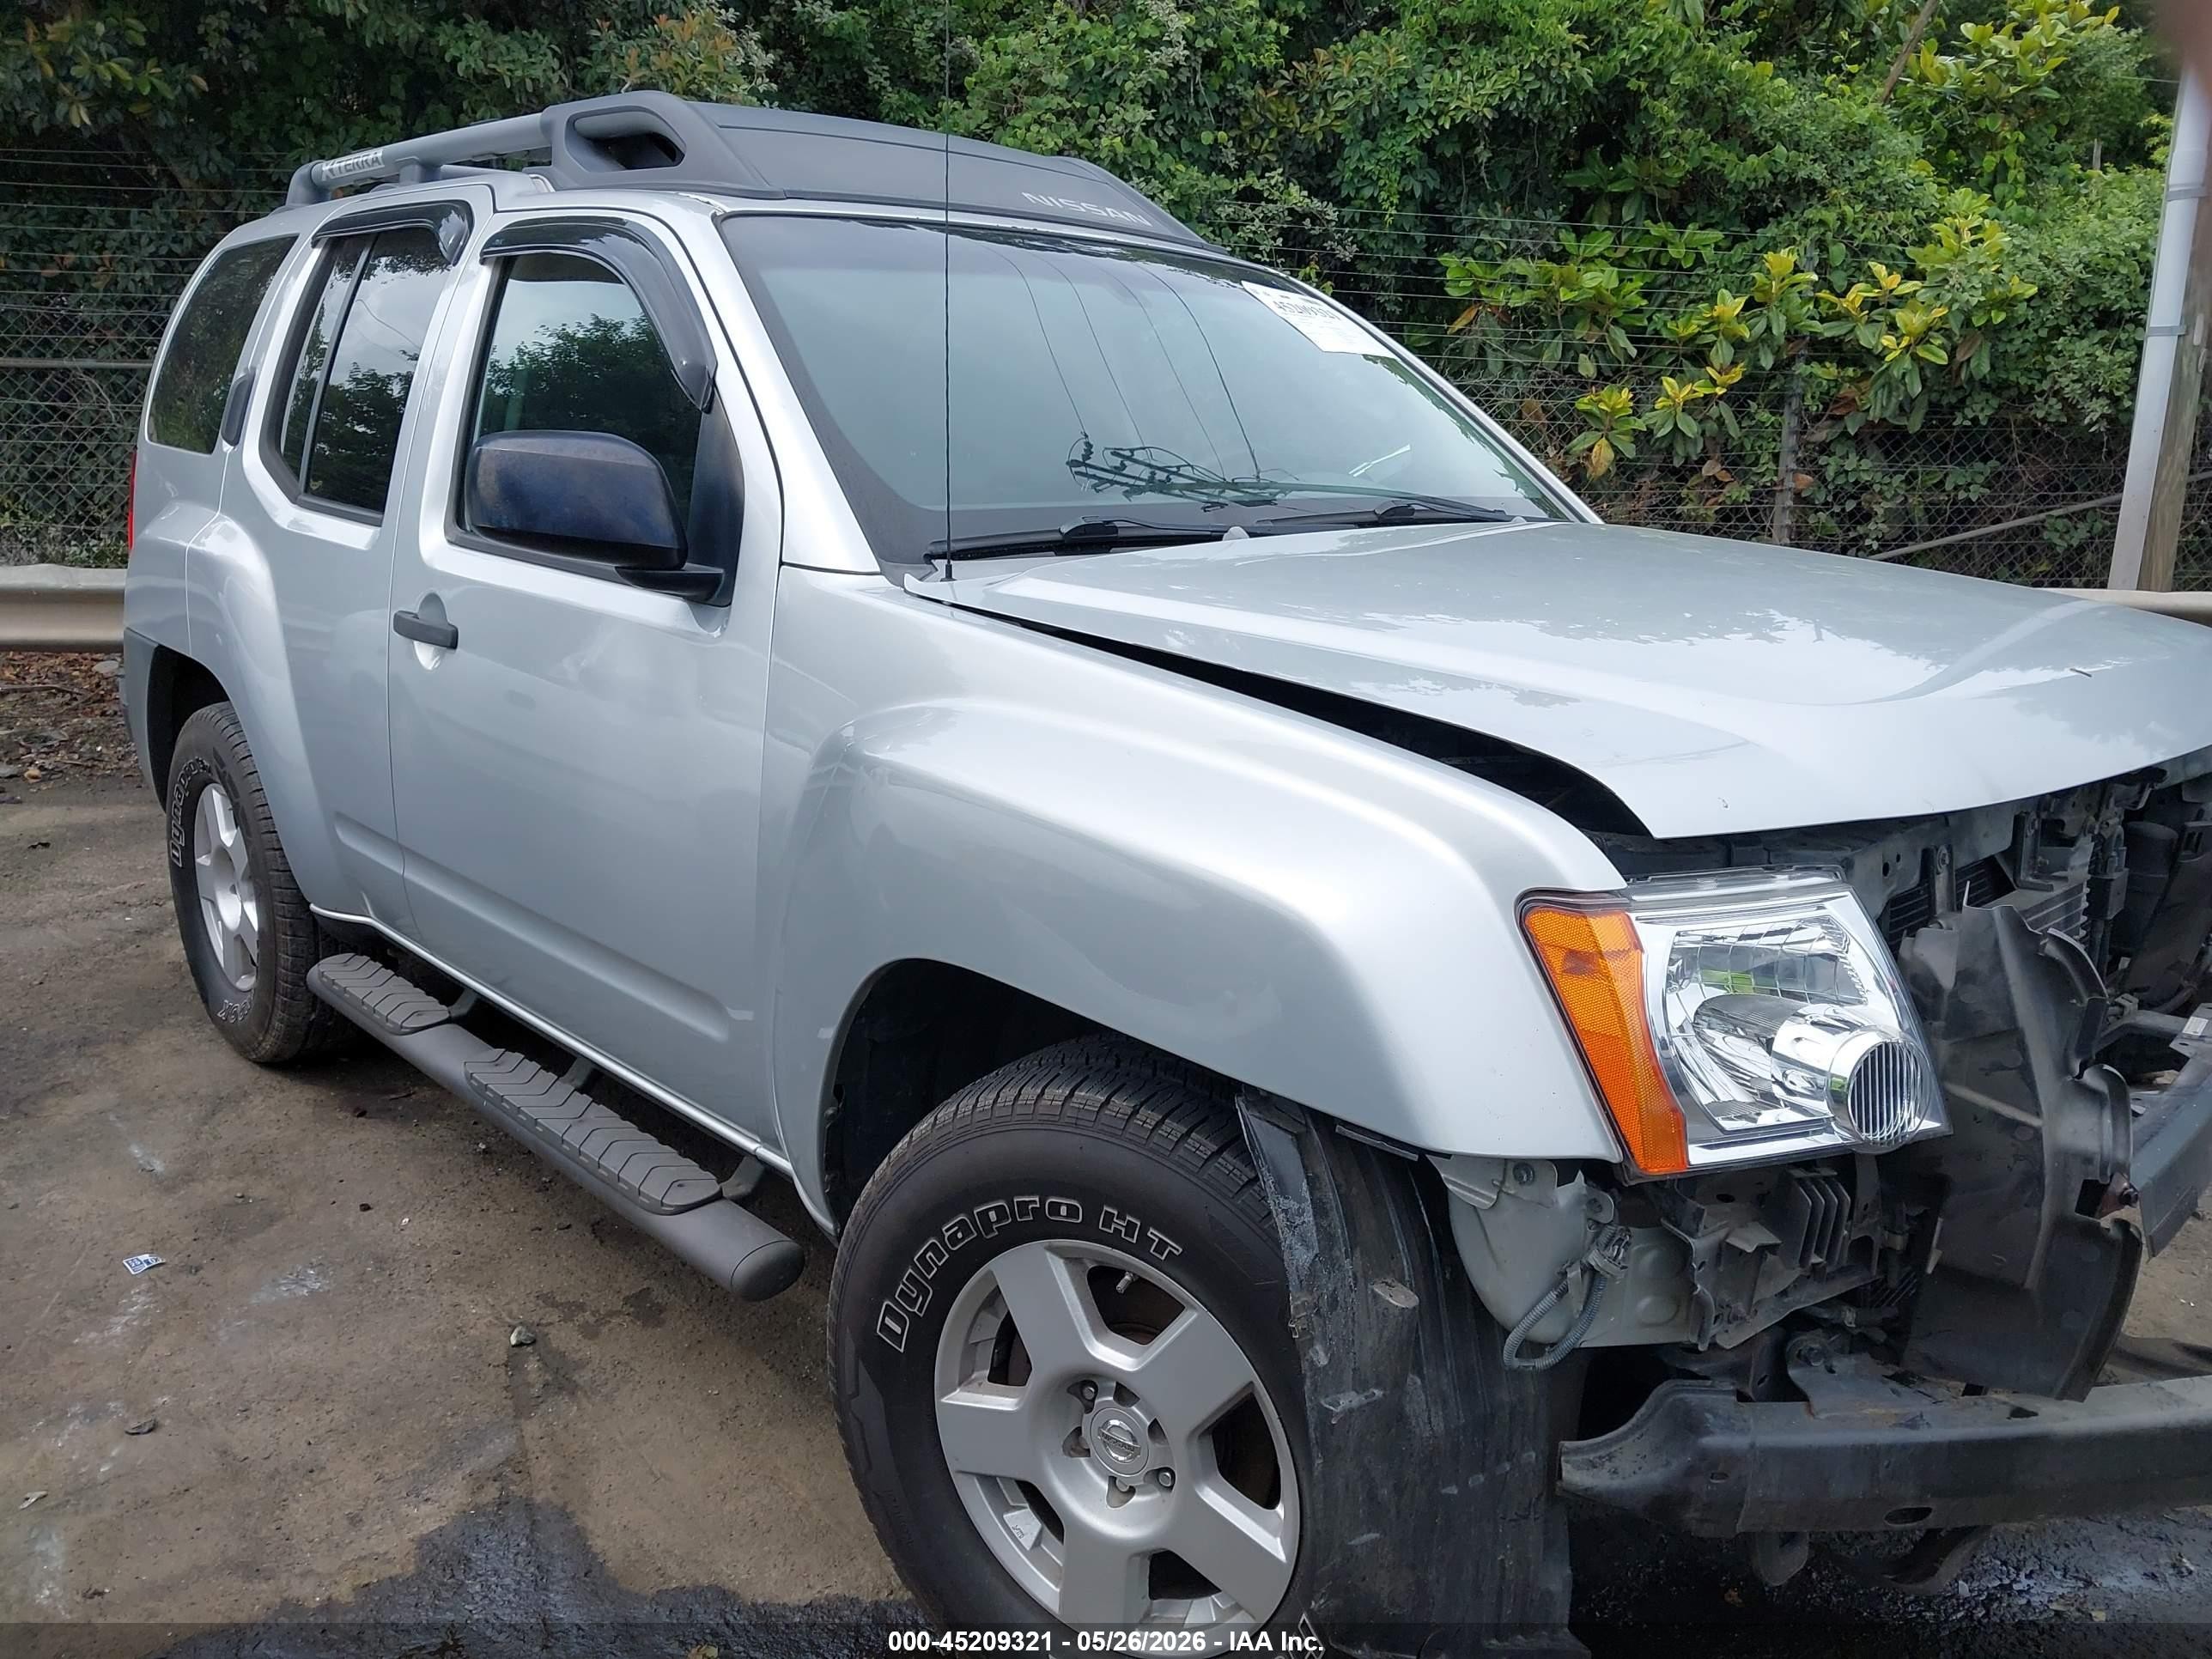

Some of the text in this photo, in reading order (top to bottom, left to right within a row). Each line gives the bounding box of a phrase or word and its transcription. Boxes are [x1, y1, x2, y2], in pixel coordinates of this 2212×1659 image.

[1022, 191, 1153, 227] NISSAN
[877, 1196, 1182, 1353] Dynapro HT
